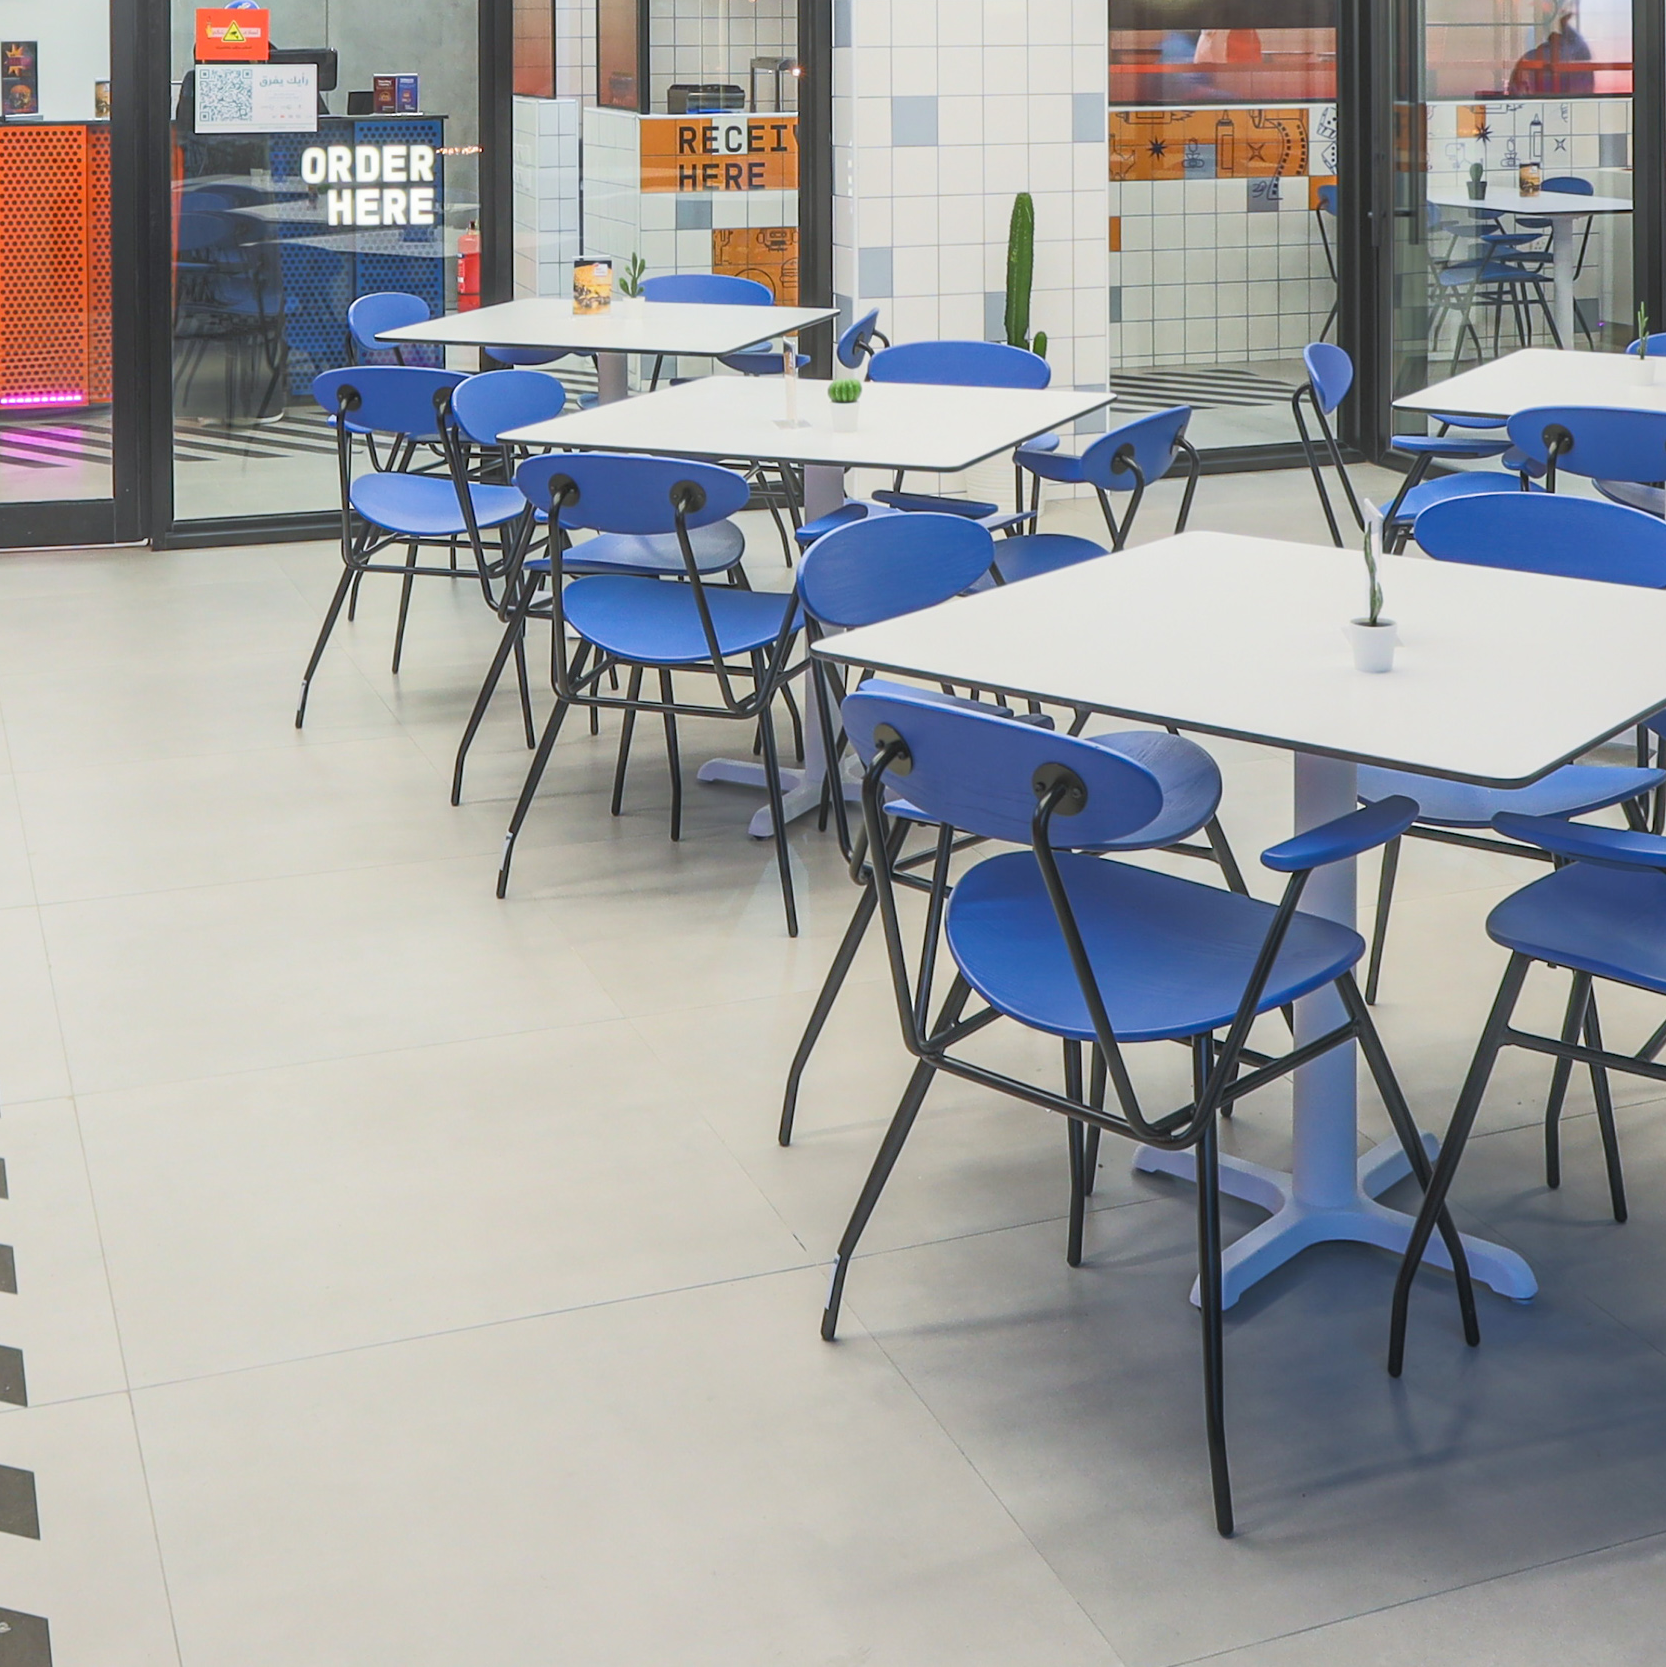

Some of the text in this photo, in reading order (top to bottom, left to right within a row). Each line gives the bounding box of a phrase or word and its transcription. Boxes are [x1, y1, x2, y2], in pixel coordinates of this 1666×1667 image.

[259, 72, 309, 88] رأيك يفرق
[301, 144, 434, 184] ORDER
[678, 162, 766, 191] HERE
[327, 188, 434, 226] HERE
